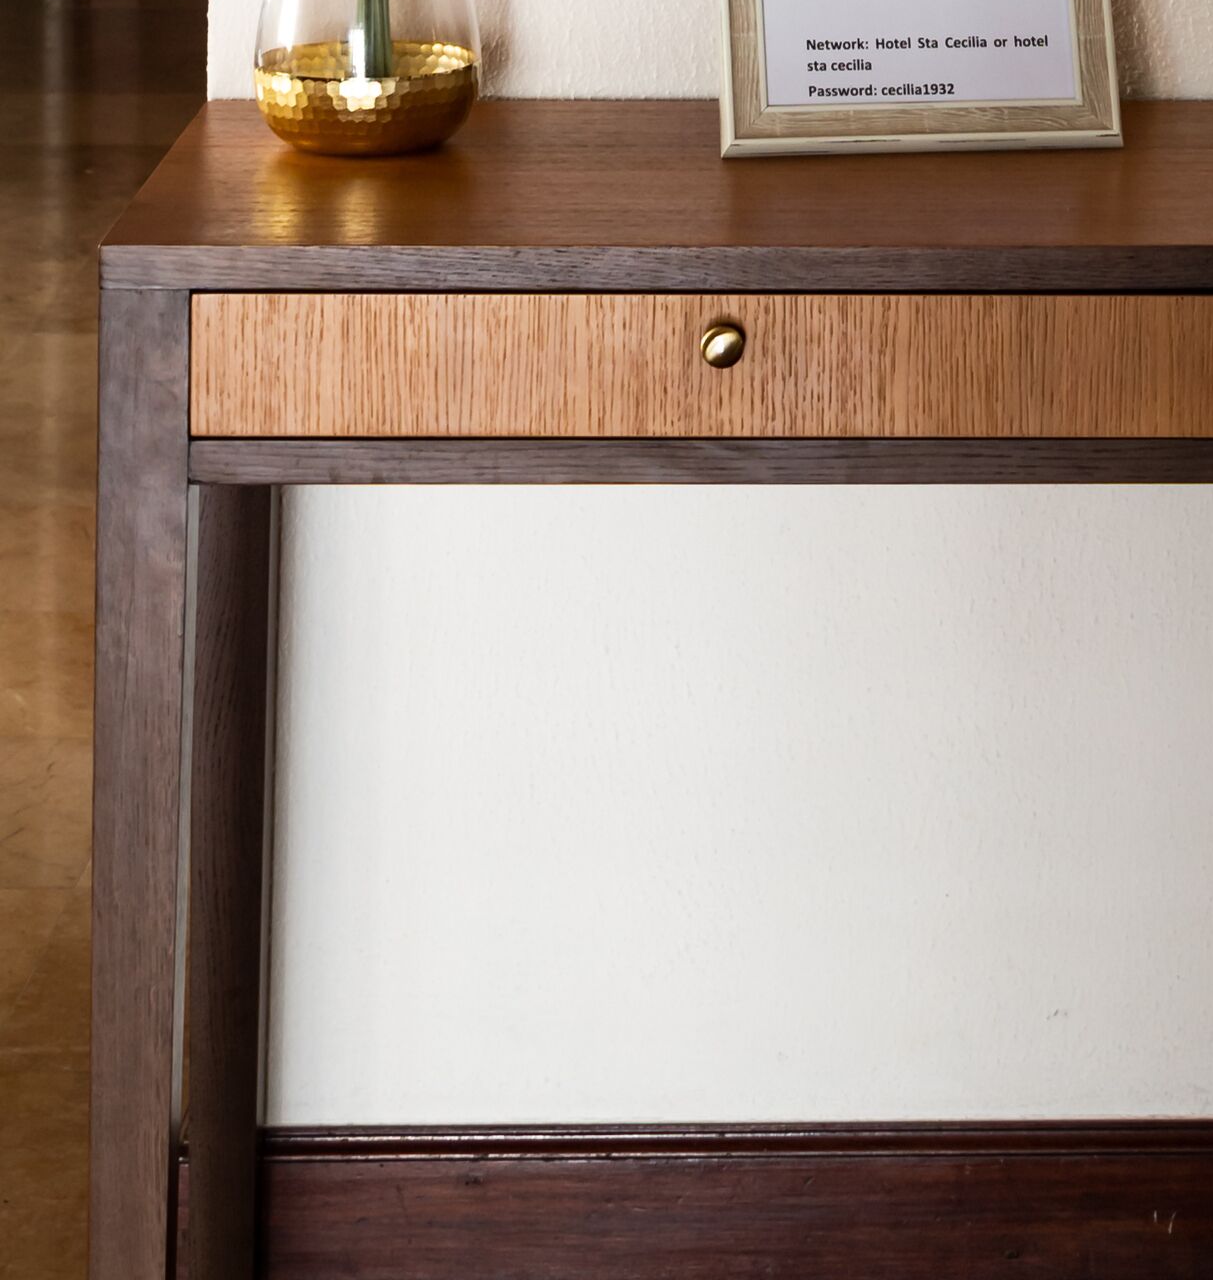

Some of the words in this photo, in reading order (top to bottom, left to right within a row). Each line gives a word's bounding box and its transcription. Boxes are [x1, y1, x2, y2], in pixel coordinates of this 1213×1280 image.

[806, 37, 869, 51] Network:
[875, 36, 912, 50] Hotel
[917, 37, 939, 49] Sta
[944, 35, 988, 49] Cecilia
[993, 38, 1009, 48] or
[1013, 34, 1049, 48] hotel
[807, 60, 827, 72] sta
[830, 58, 873, 72] cecilia
[808, 83, 878, 98] Password:
[881, 82, 955, 96] cecilia1932
